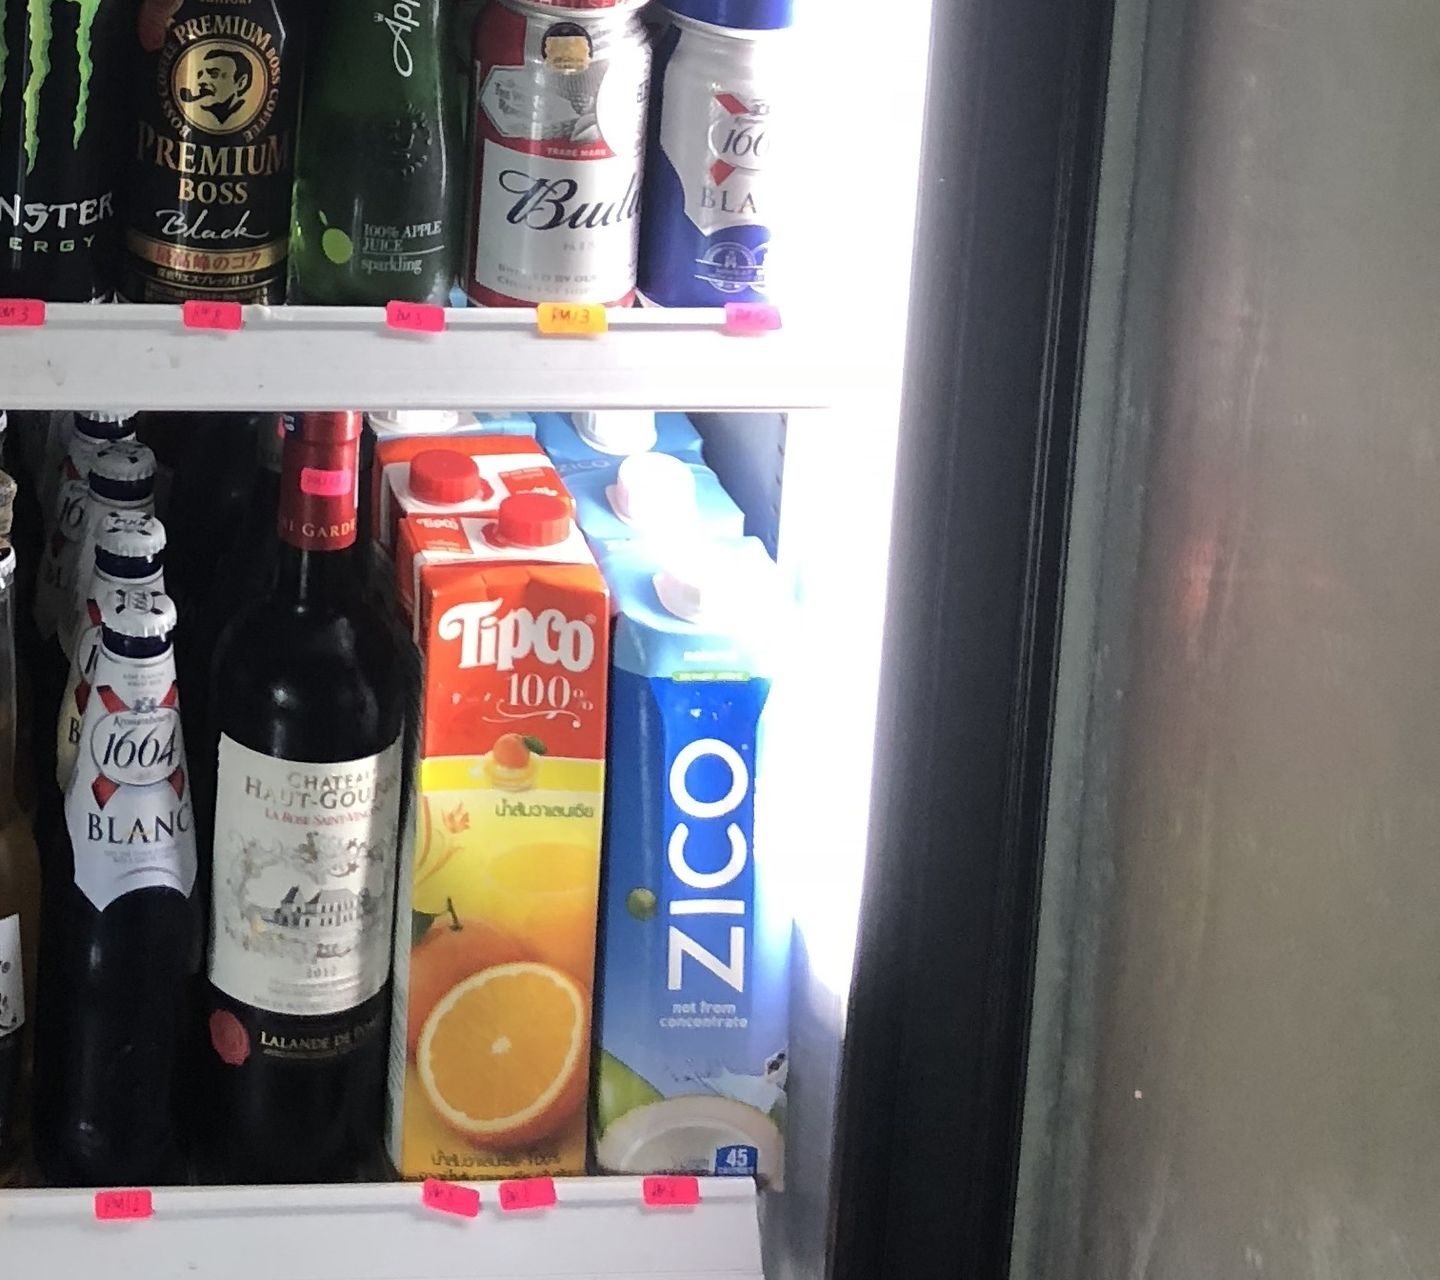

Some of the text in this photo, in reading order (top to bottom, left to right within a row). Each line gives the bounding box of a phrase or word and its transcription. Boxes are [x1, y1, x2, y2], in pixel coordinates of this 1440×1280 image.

[174, 14, 271, 49] PREMIUM
[137, 121, 289, 177] PREMIUM
[178, 177, 248, 205] BOSS
[156, 209, 271, 240] Black
[363, 219, 442, 239] 100% APPLE
[361, 256, 423, 275] sparkling
[437, 597, 594, 673] Tipco
[506, 673, 594, 713] 100%
[102, 728, 177, 769] 1664
[87, 803, 191, 846] BLANC
[668, 738, 750, 992] ZICO
[659, 1014, 748, 1029] concentrate
[672, 1001, 696, 1015] not
[726, 1147, 748, 1168] 45
